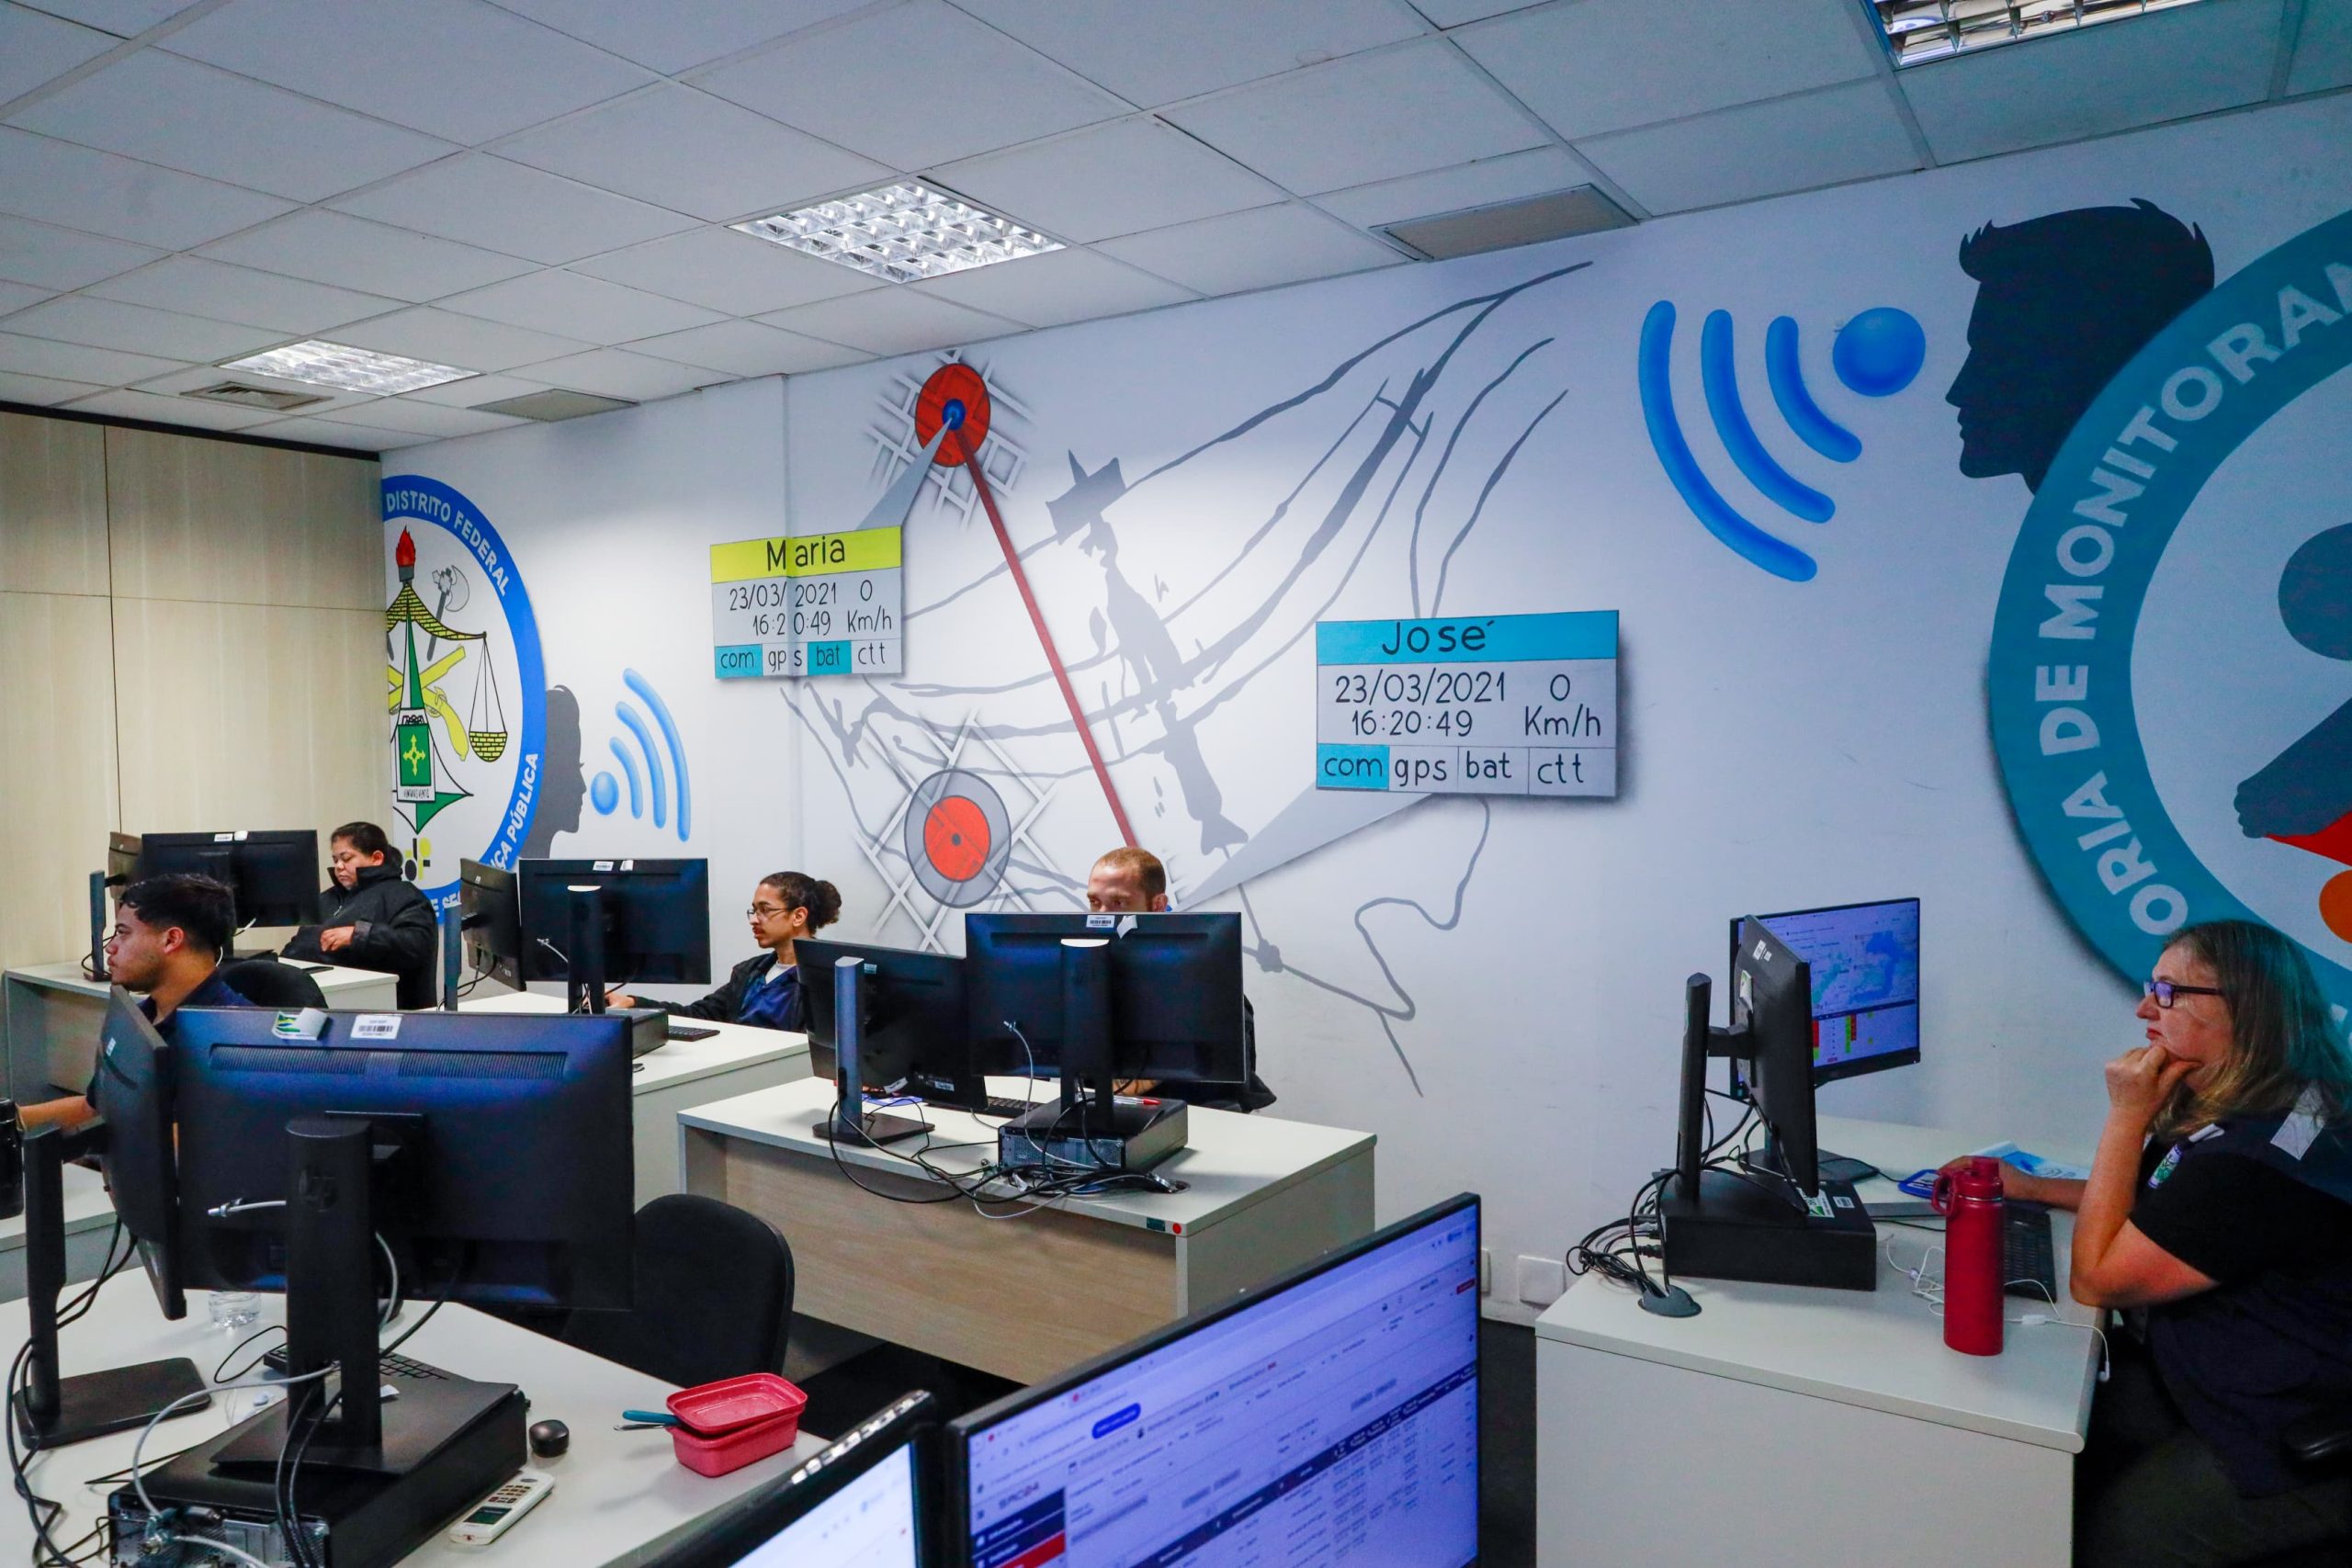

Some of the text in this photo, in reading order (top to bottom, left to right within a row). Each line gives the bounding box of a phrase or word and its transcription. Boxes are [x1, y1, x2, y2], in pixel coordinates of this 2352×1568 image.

[386, 491, 510, 596] DISTRITO FEDERAL
[766, 536, 845, 571] Maria
[729, 581, 837, 611] 23/03/2021
[752, 611, 831, 636] 16:20:49
[847, 604, 892, 633] Km/h
[1382, 620, 1495, 655] José
[720, 650, 754, 669] com
[768, 649, 803, 672] gps
[816, 645, 841, 667] bat
[858, 642, 886, 665] ctt
[1335, 668, 1505, 705] 23/03/2021
[1351, 710, 1473, 737] 16:20:49
[1525, 704, 1600, 737] Km/h
[2035, 665, 2101, 756] DE
[1324, 757, 1383, 777] com
[1395, 758, 1447, 786] gps
[1466, 750, 1512, 778] bat
[1537, 753, 1584, 784] ctt
[490, 840, 513, 870] ÇA
[507, 753, 538, 843] PÚBLICA
[2061, 770, 2188, 935] ORIA
